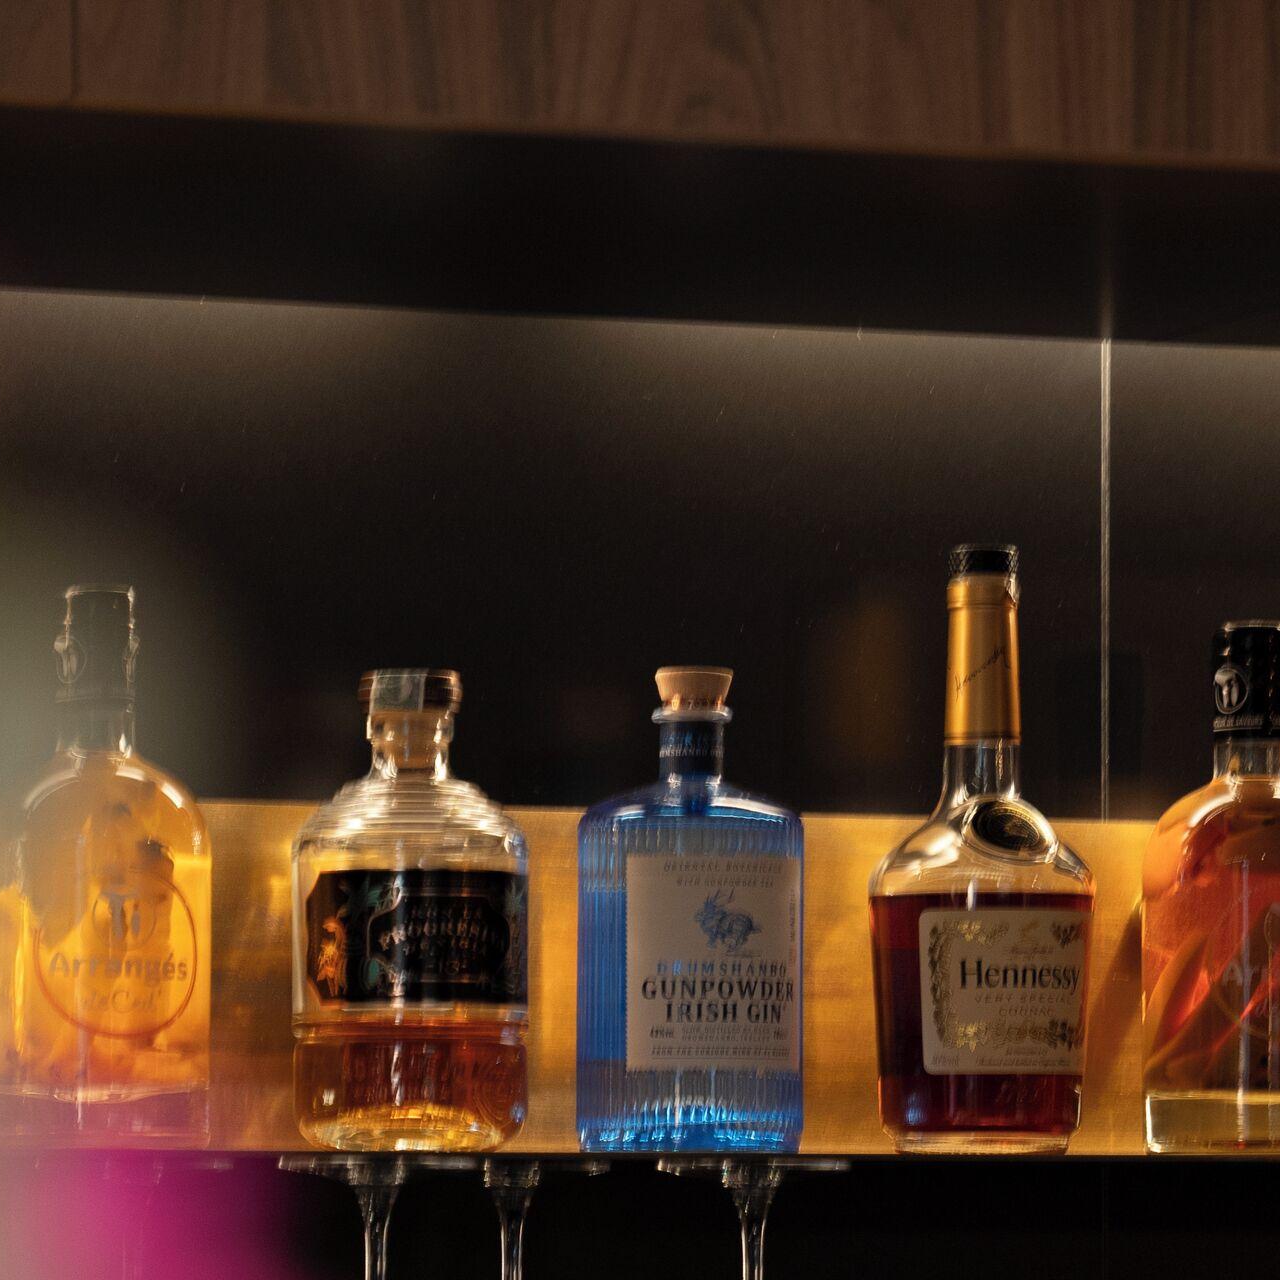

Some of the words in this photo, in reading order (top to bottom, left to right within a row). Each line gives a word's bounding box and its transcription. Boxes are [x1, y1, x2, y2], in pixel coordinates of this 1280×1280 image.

[657, 958, 787, 978] DRUMSHANBO
[959, 957, 1080, 996] Hennessy
[641, 977, 794, 1002] GUNPOWDER
[665, 1000, 738, 1024] IRISH
